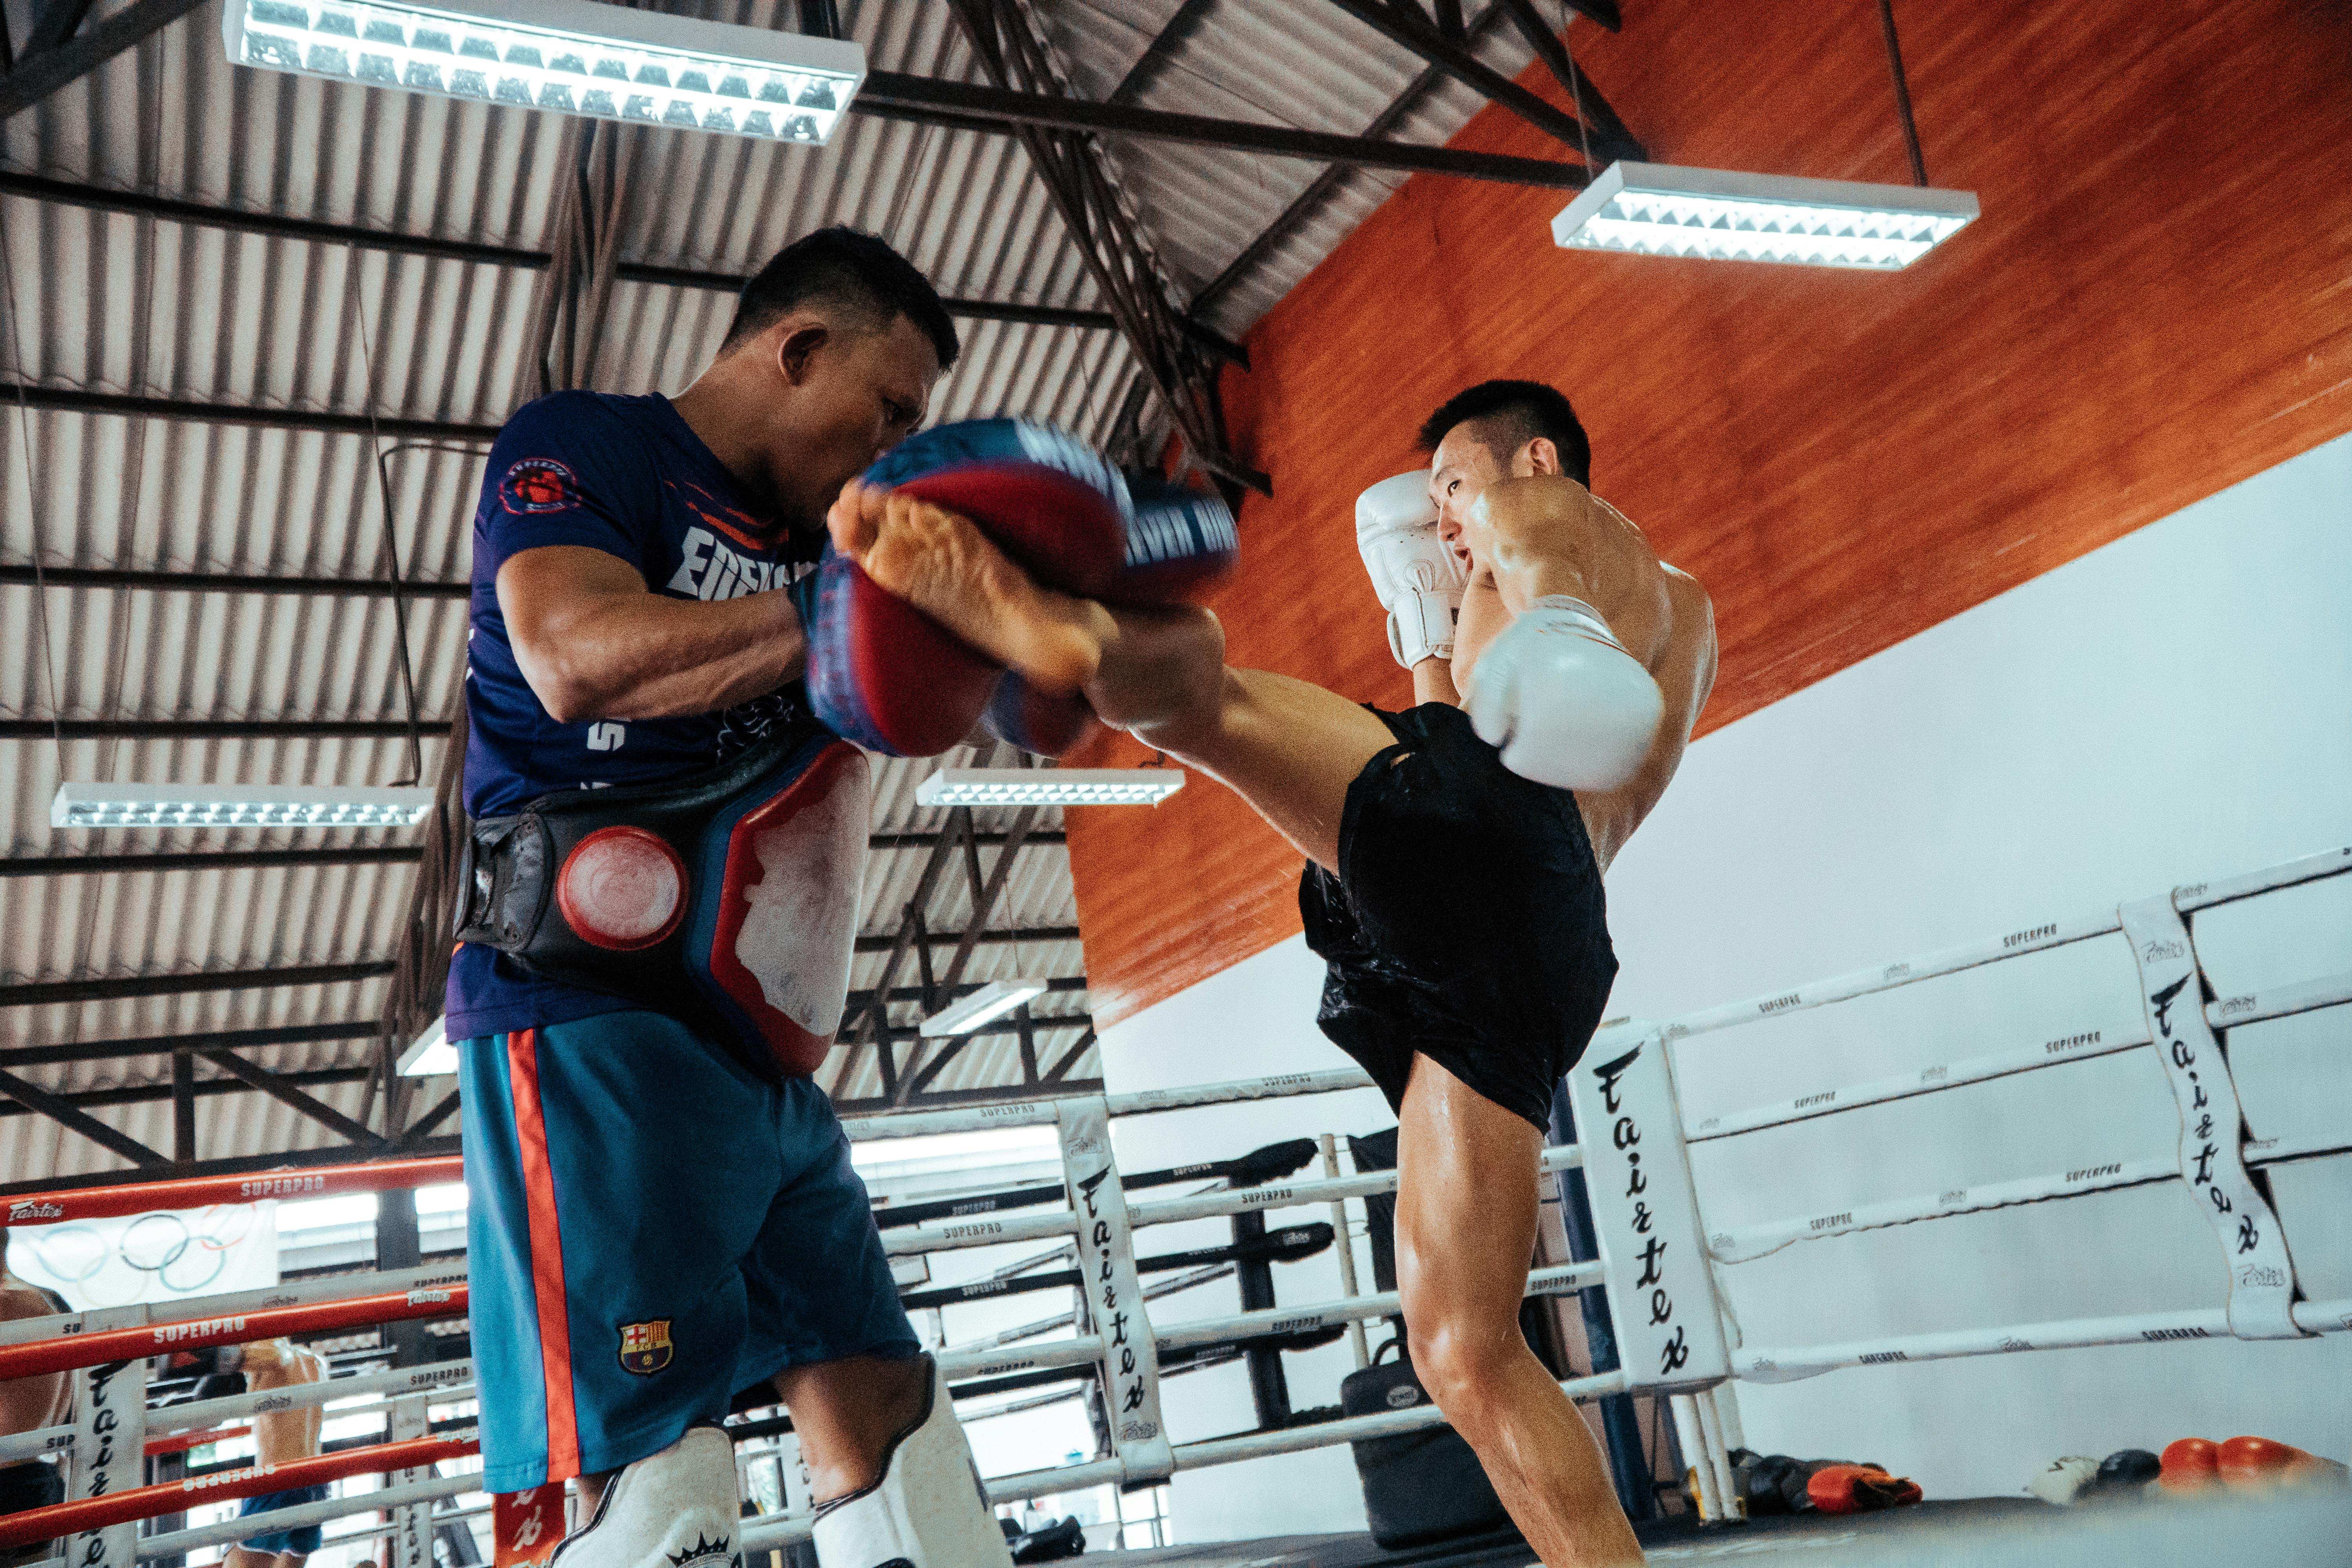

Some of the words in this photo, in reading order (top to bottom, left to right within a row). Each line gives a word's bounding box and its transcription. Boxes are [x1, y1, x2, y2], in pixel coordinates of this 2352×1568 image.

[2004, 924, 2056, 947] SUPERPRO
[1759, 994, 1800, 1013] SUPERPRO
[2046, 1031, 2100, 1053] SUPERPRO
[1263, 1074, 1311, 1086] SUPERPRO
[1795, 1091, 1835, 1109] SUPERPRO
[982, 1105, 1035, 1117] SUPERPRO
[2151, 971, 2260, 1253] Fairtex
[2067, 1163, 2121, 1182] SUPERPRO
[242, 1177, 324, 1196] SUPERPRO
[1242, 1189, 1292, 1203] SUPERPRO
[9, 1200, 63, 1221] Fairtex
[1593, 1041, 1689, 1376] Fairtex
[1811, 1212, 1852, 1230] SUPERPRO
[945, 1223, 1002, 1239] SUPERPRO
[1076, 1164, 1144, 1413] Fairtex
[1532, 1275, 1576, 1290] SUPERPRO
[154, 1318, 245, 1343] SUPERPRO
[410, 1367, 468, 1384] SUPERPRO
